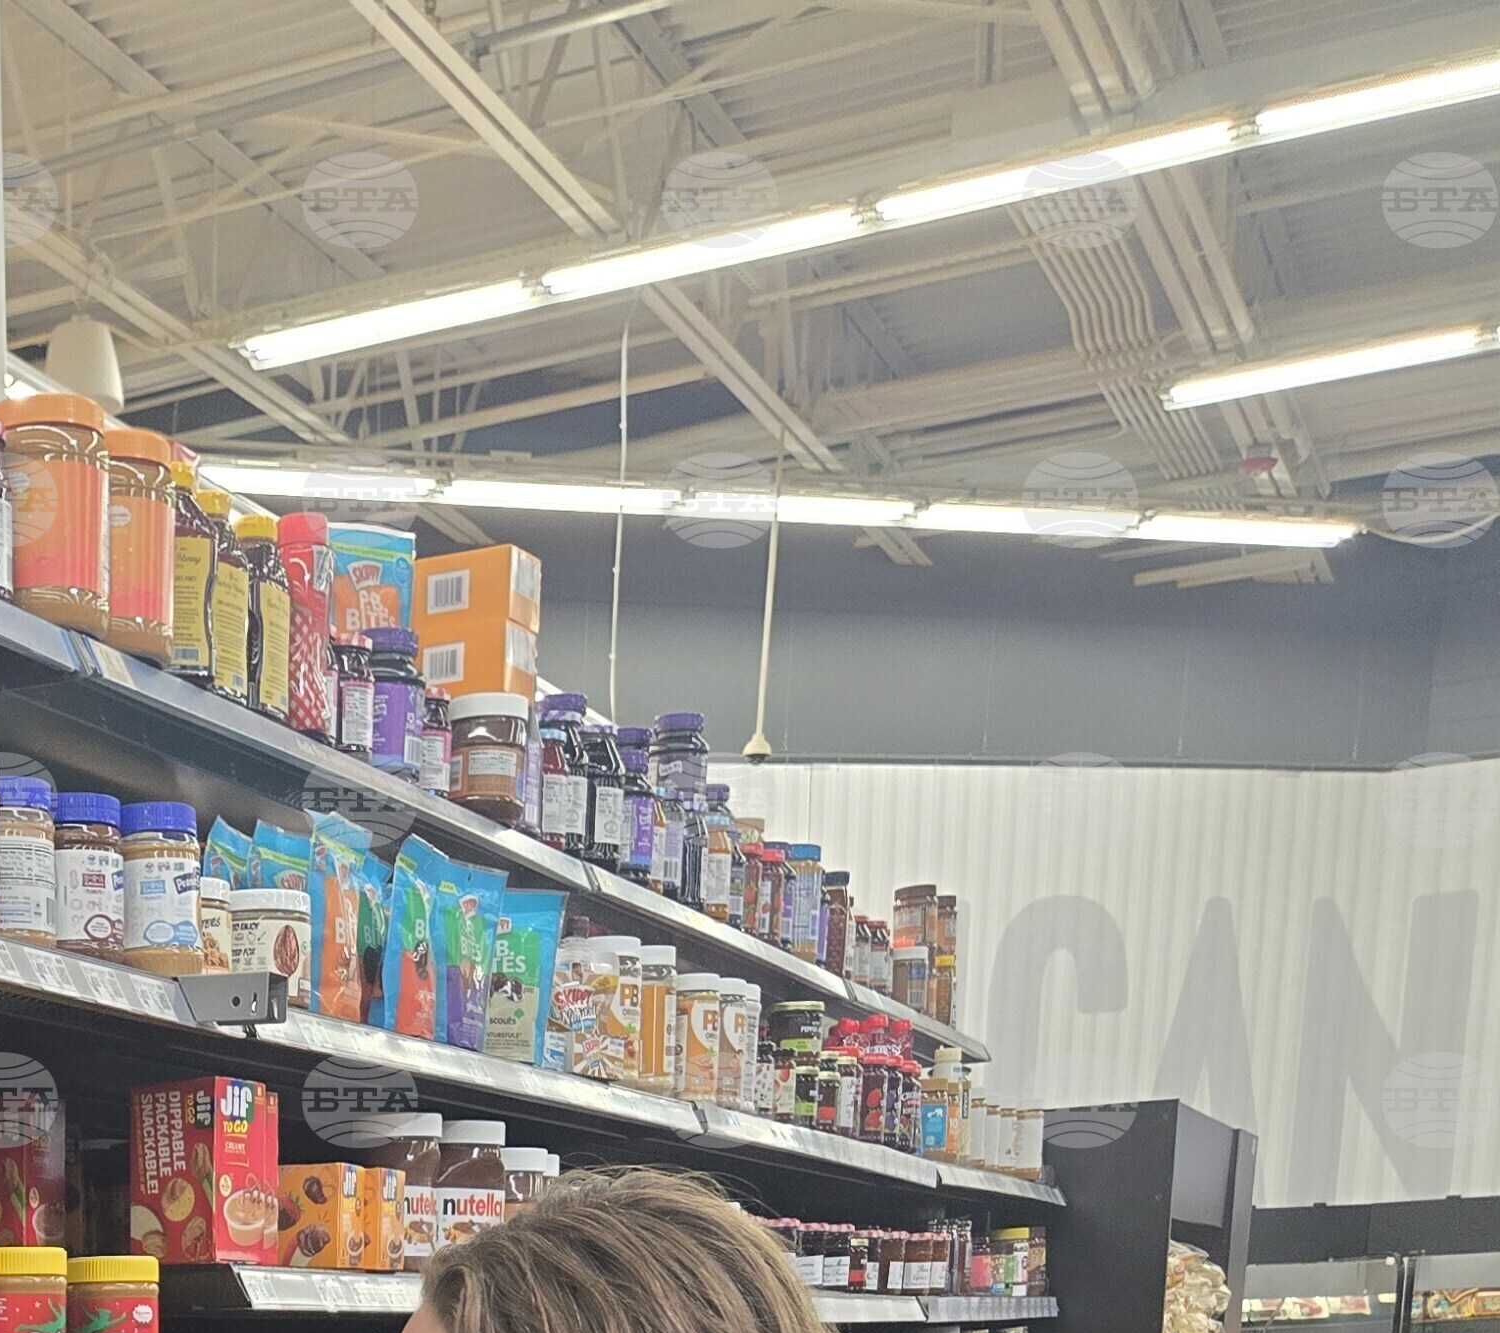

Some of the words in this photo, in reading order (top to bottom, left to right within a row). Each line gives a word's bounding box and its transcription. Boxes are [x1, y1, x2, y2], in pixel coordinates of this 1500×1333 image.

[554, 988, 595, 1010] SKIPPY
[155, 1092, 172, 1177] PACKABLE
[168, 1090, 186, 1171] DIPPABLE
[220, 1084, 252, 1117] Jif
[141, 1094, 159, 1194] SNACKABLE!
